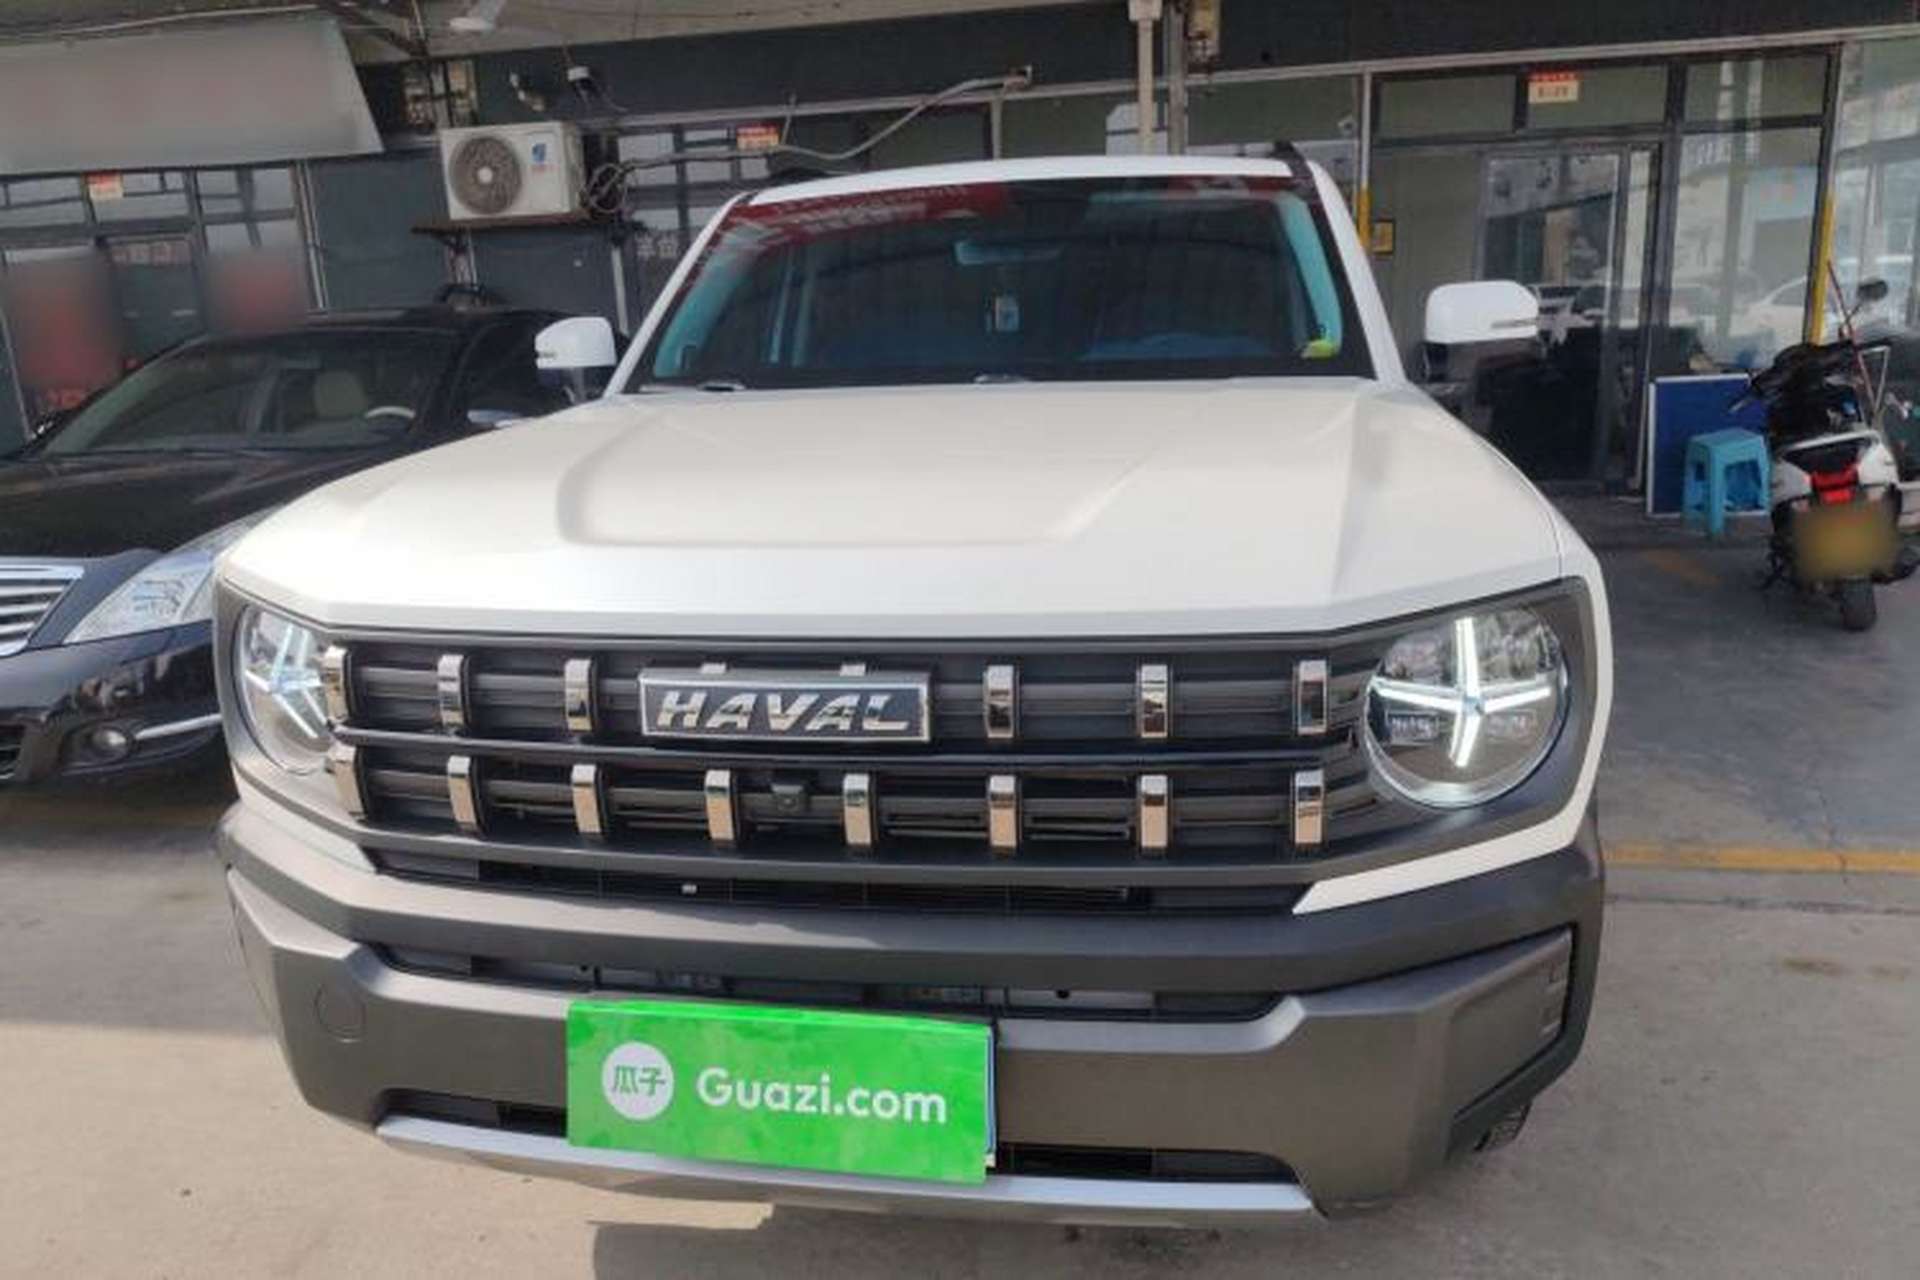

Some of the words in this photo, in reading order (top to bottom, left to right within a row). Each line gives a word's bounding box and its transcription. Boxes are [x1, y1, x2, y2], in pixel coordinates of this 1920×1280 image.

[656, 690, 909, 731] HAVAL
[610, 1064, 667, 1098] 瓜子
[696, 1066, 947, 1124] Guazi.com
